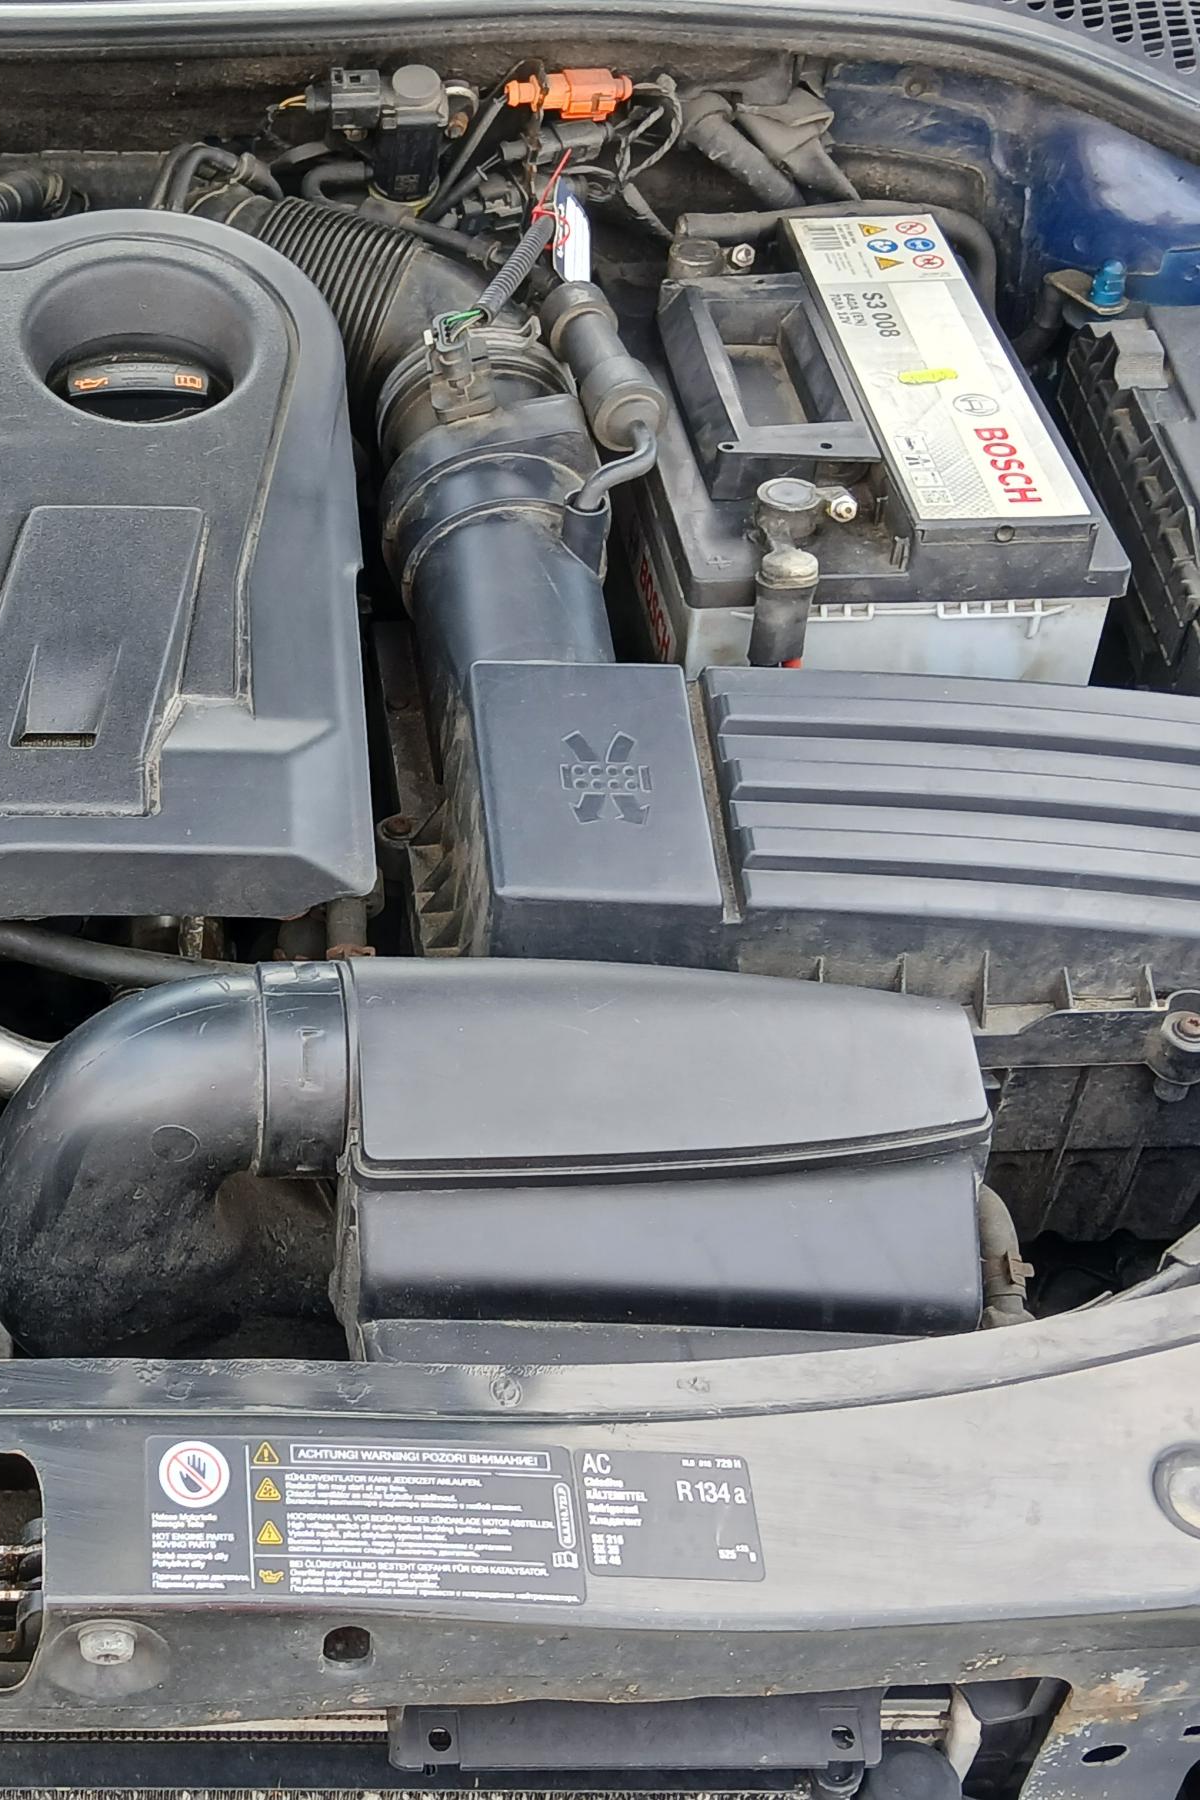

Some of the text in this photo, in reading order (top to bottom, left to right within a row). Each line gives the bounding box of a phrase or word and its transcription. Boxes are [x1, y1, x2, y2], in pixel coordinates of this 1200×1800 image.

[862, 293, 888, 309] S3
[872, 313, 901, 337] 008
[974, 428, 1042, 503] BOSCH
[361, 1451, 420, 1462] WARNING!
[422, 1453, 466, 1464] POZOR!
[583, 1453, 611, 1474] AC
[172, 1533, 204, 1541] ENGINE
[206, 1533, 234, 1541] PARTS
[188, 1541, 216, 1549] PARTS
